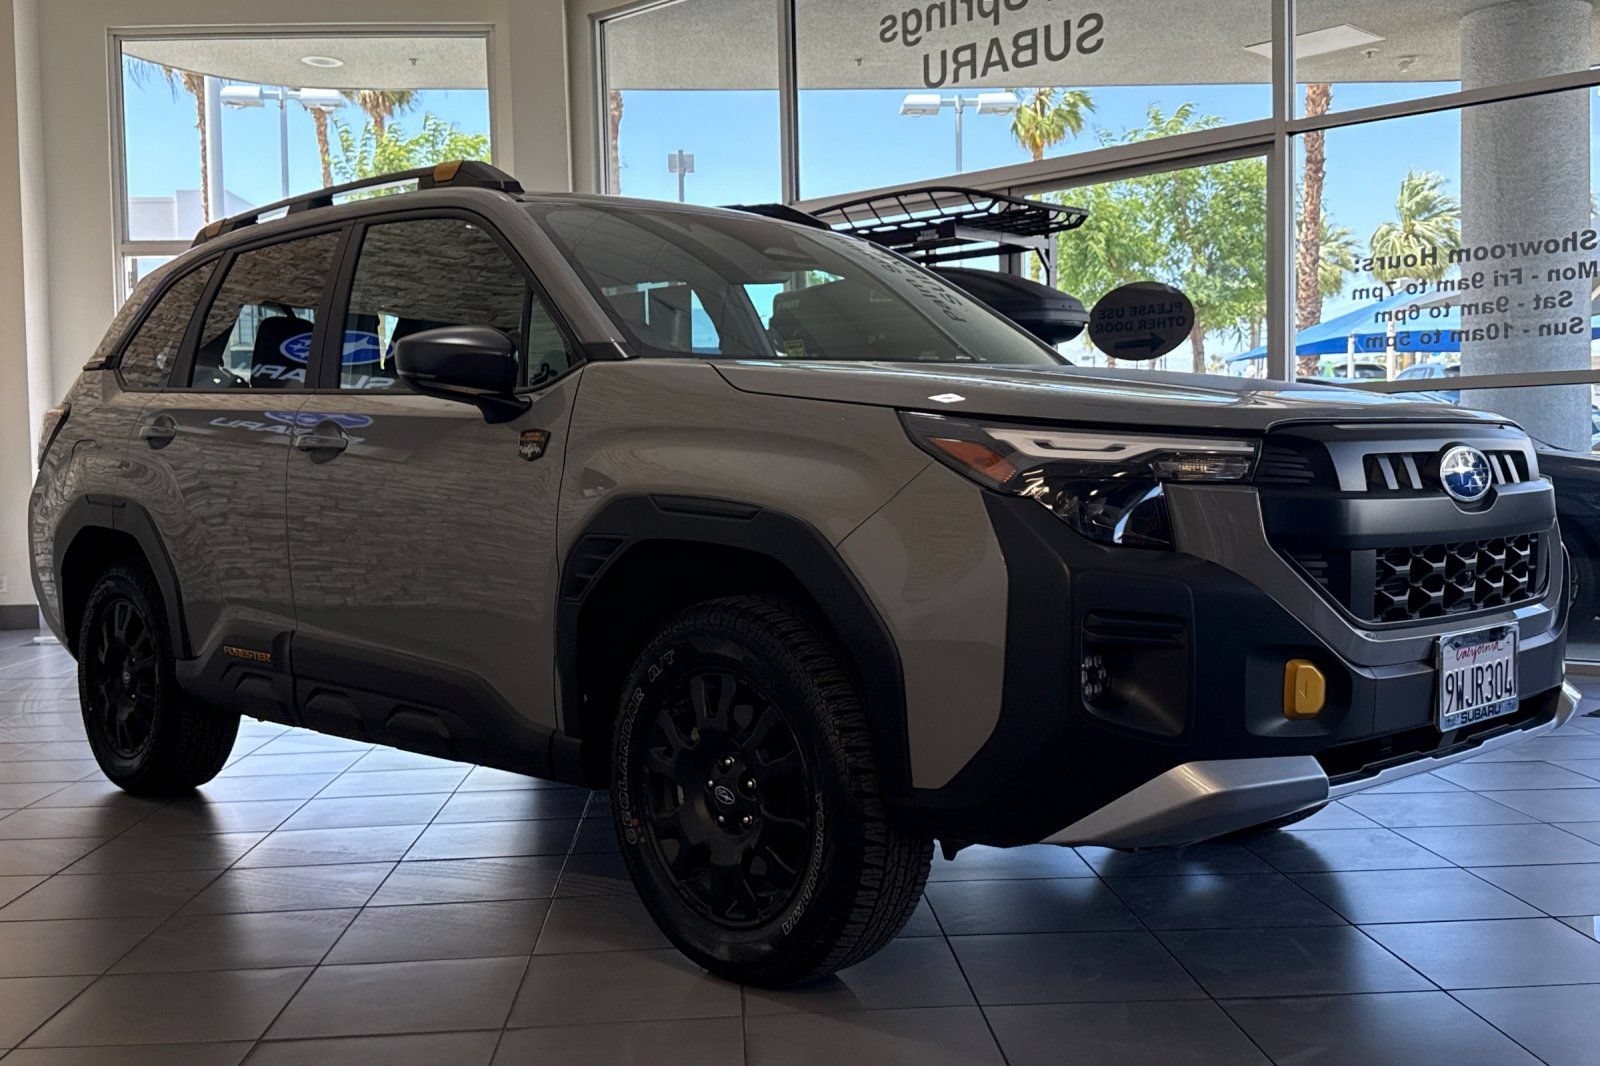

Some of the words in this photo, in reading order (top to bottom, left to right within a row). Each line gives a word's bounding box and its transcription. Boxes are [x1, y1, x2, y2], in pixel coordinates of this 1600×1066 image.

[1445, 658, 1513, 715] 9WJR304
[1460, 703, 1501, 724] SUBARU
[618, 687, 645, 845] GEOLANDAR
[648, 650, 675, 683] A/T
